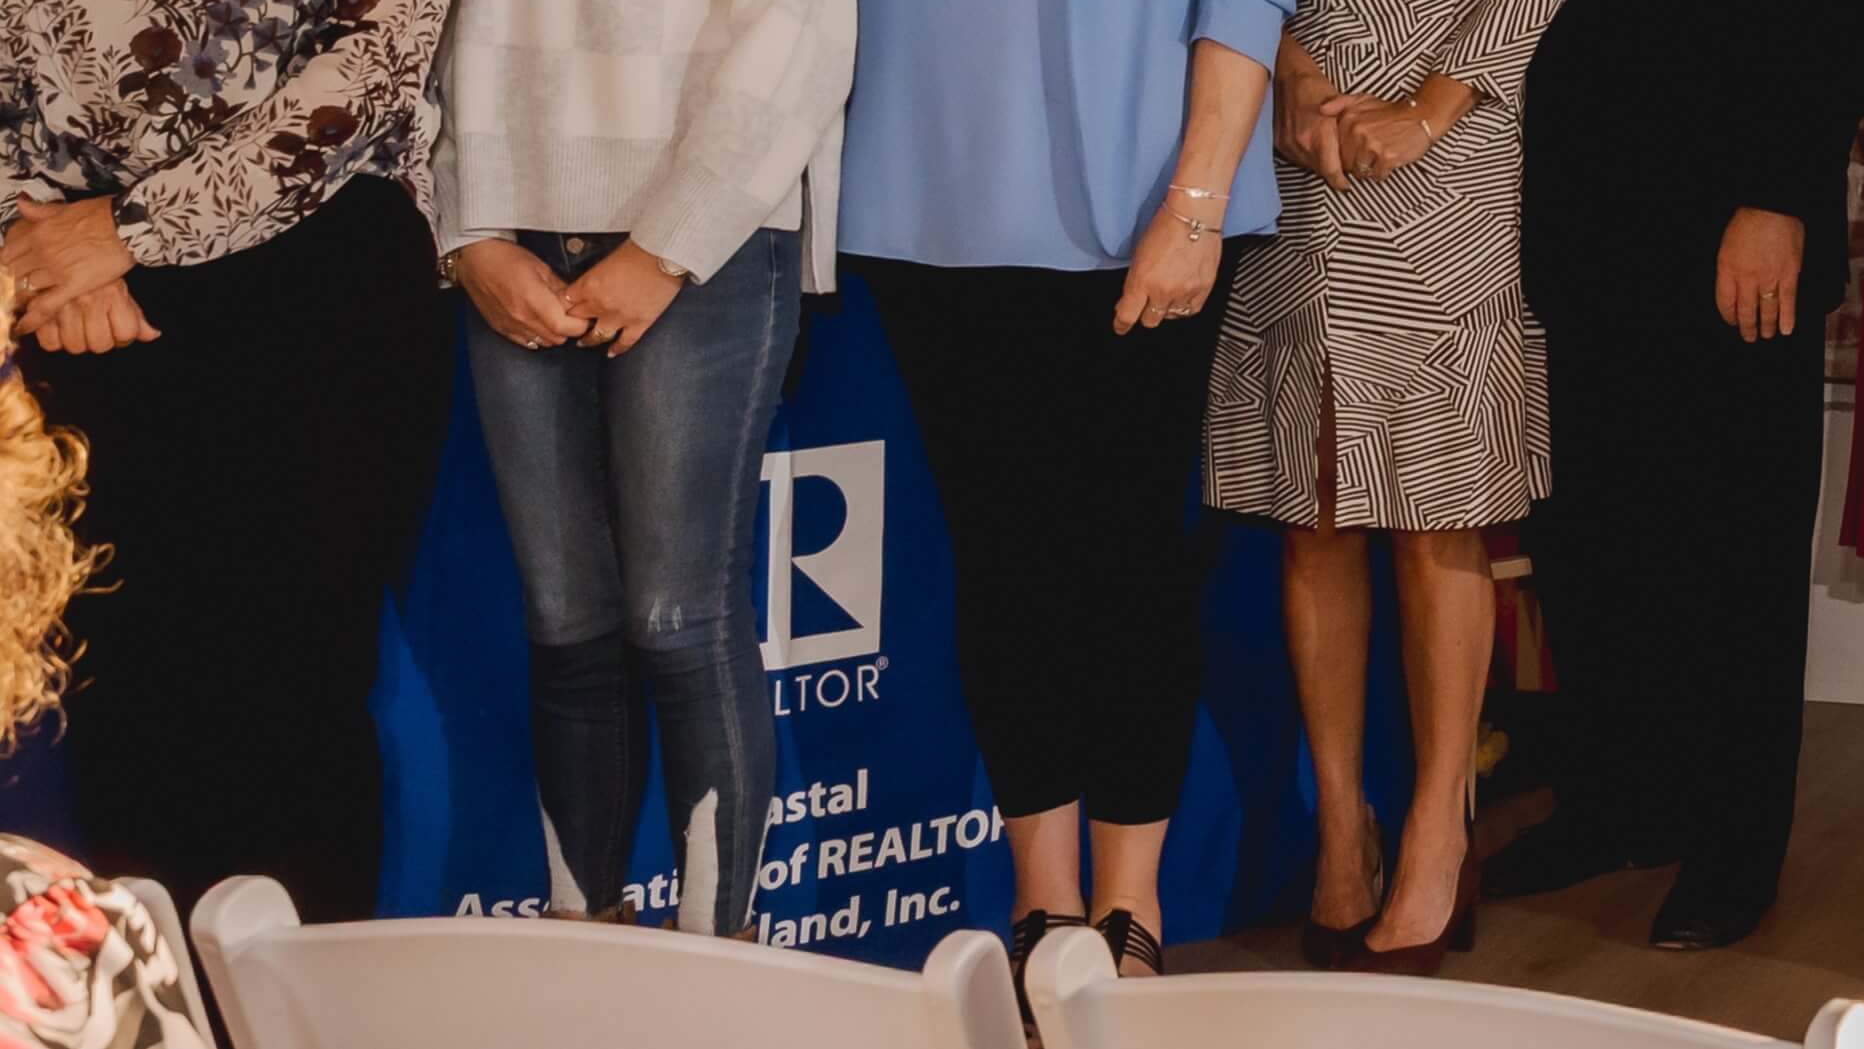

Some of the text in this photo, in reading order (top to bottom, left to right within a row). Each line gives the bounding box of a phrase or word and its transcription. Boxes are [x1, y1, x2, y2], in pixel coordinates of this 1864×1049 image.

[767, 768, 869, 826] astal
[759, 843, 810, 891] of
[817, 805, 1005, 880] REALTO
[884, 886, 961, 928] Inc.
